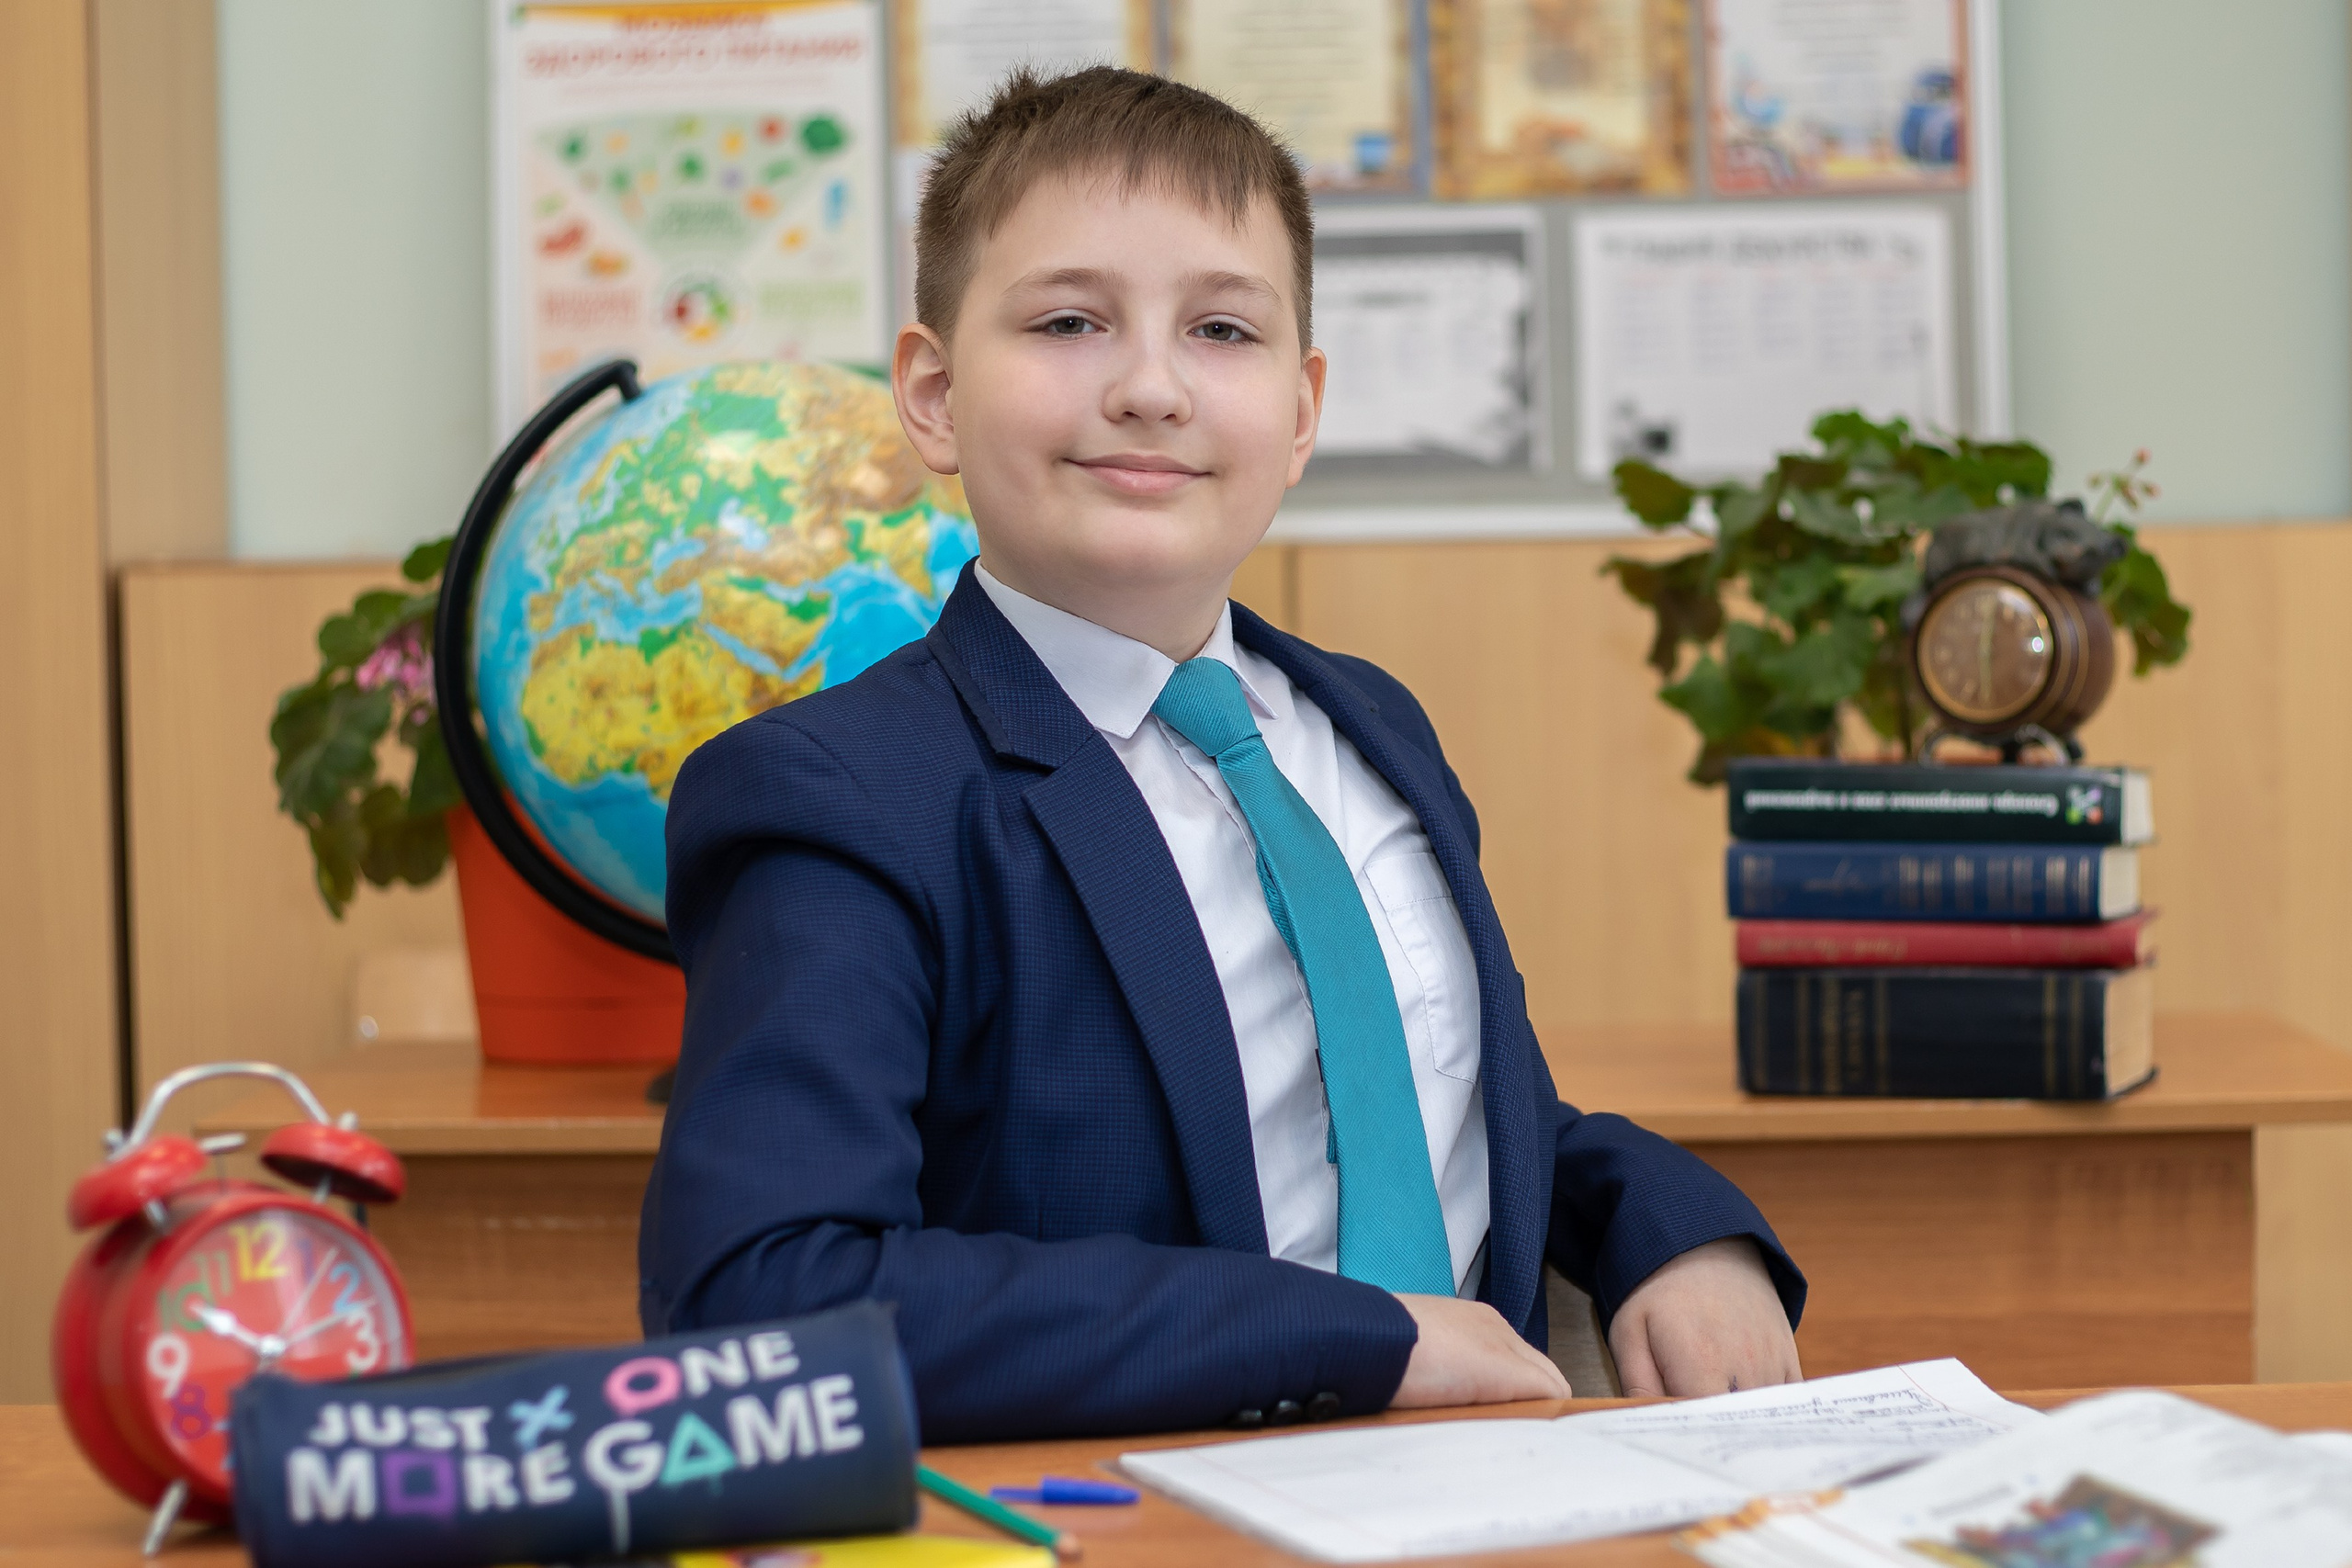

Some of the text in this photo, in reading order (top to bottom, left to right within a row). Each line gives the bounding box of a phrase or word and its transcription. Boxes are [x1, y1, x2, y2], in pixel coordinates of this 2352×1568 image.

[230, 1218, 288, 1282] 12
[156, 1282, 215, 1334] 10
[329, 1262, 368, 1314] 2
[146, 1333, 190, 1398] 9
[345, 1307, 380, 1371] 3
[171, 1383, 212, 1440] 8
[309, 1331, 800, 1451] JUST ONE
[287, 1373, 865, 1523] MORE GAME
